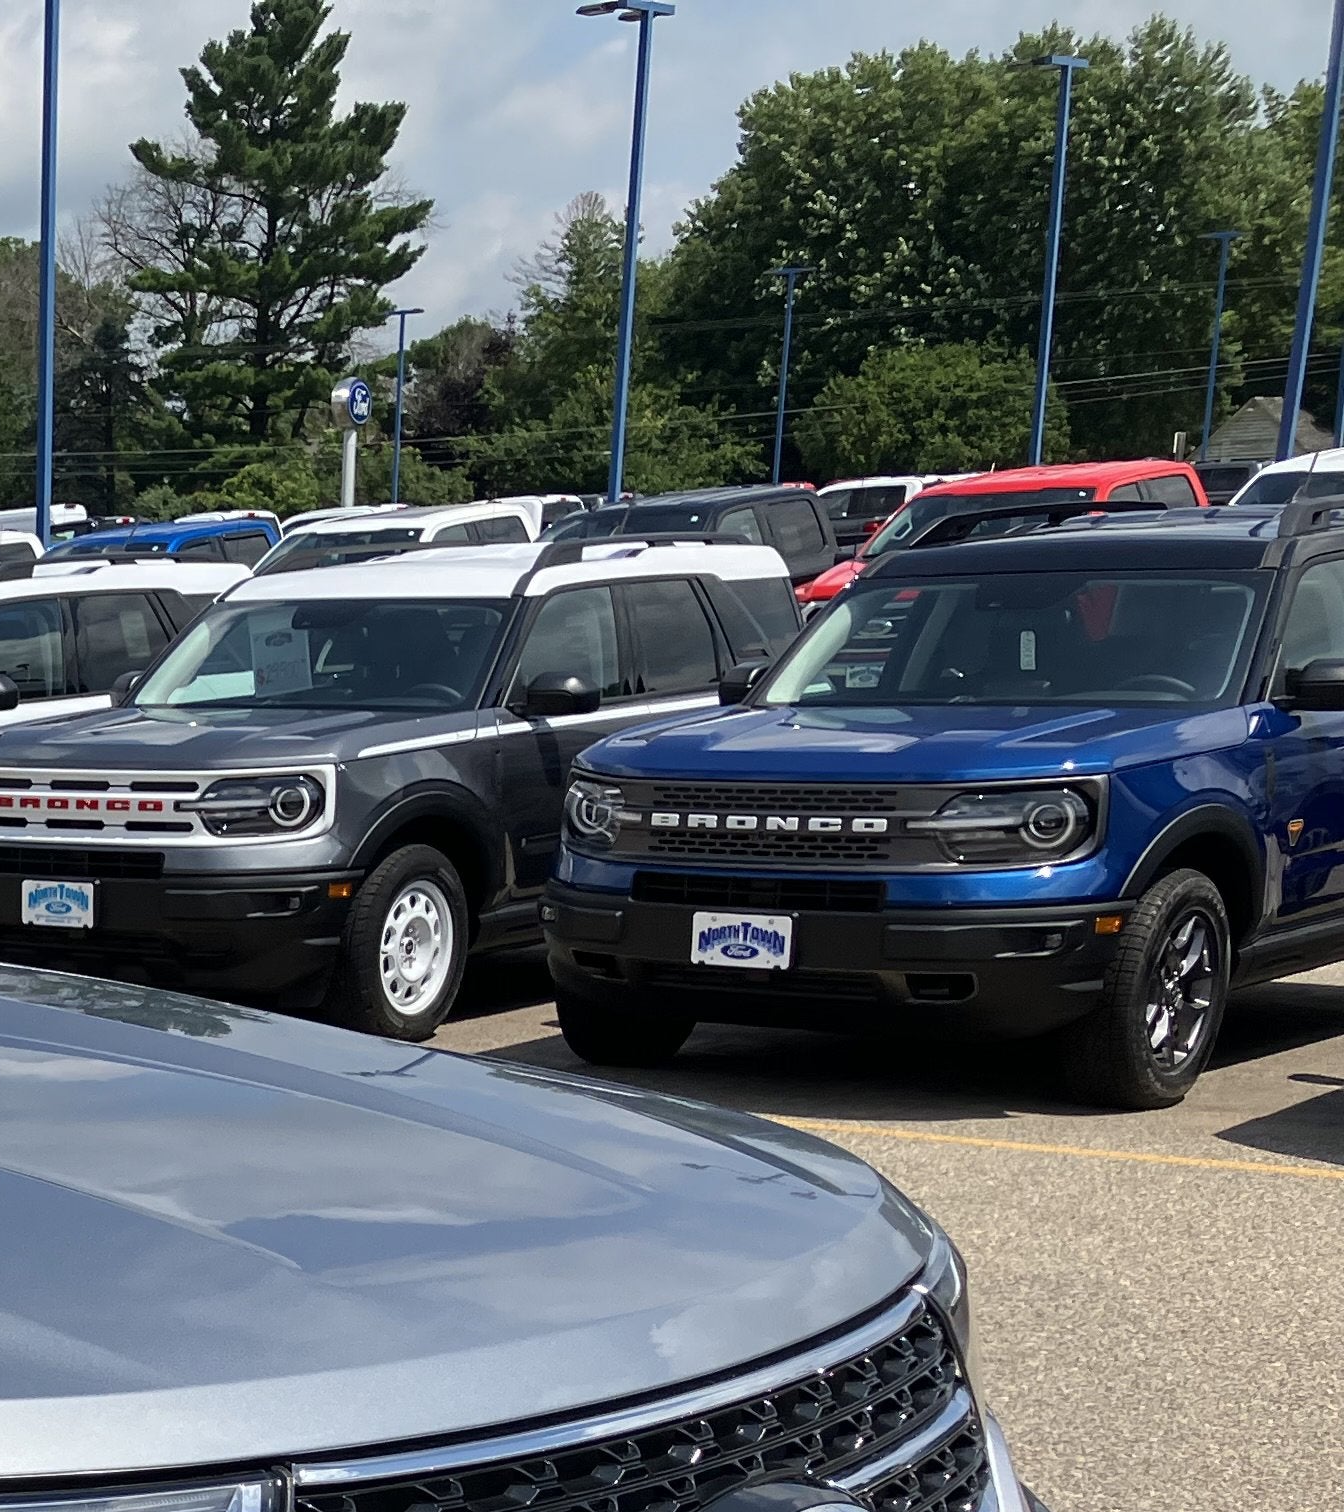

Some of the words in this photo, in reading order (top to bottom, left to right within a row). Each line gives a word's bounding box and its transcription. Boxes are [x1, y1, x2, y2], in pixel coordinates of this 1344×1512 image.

[353, 387, 370, 416] Ford
[650, 812, 888, 834] BRONCO
[698, 925, 741, 952] NORTH
[741, 922, 786, 957] TOWN
[726, 945, 753, 957] Ford
